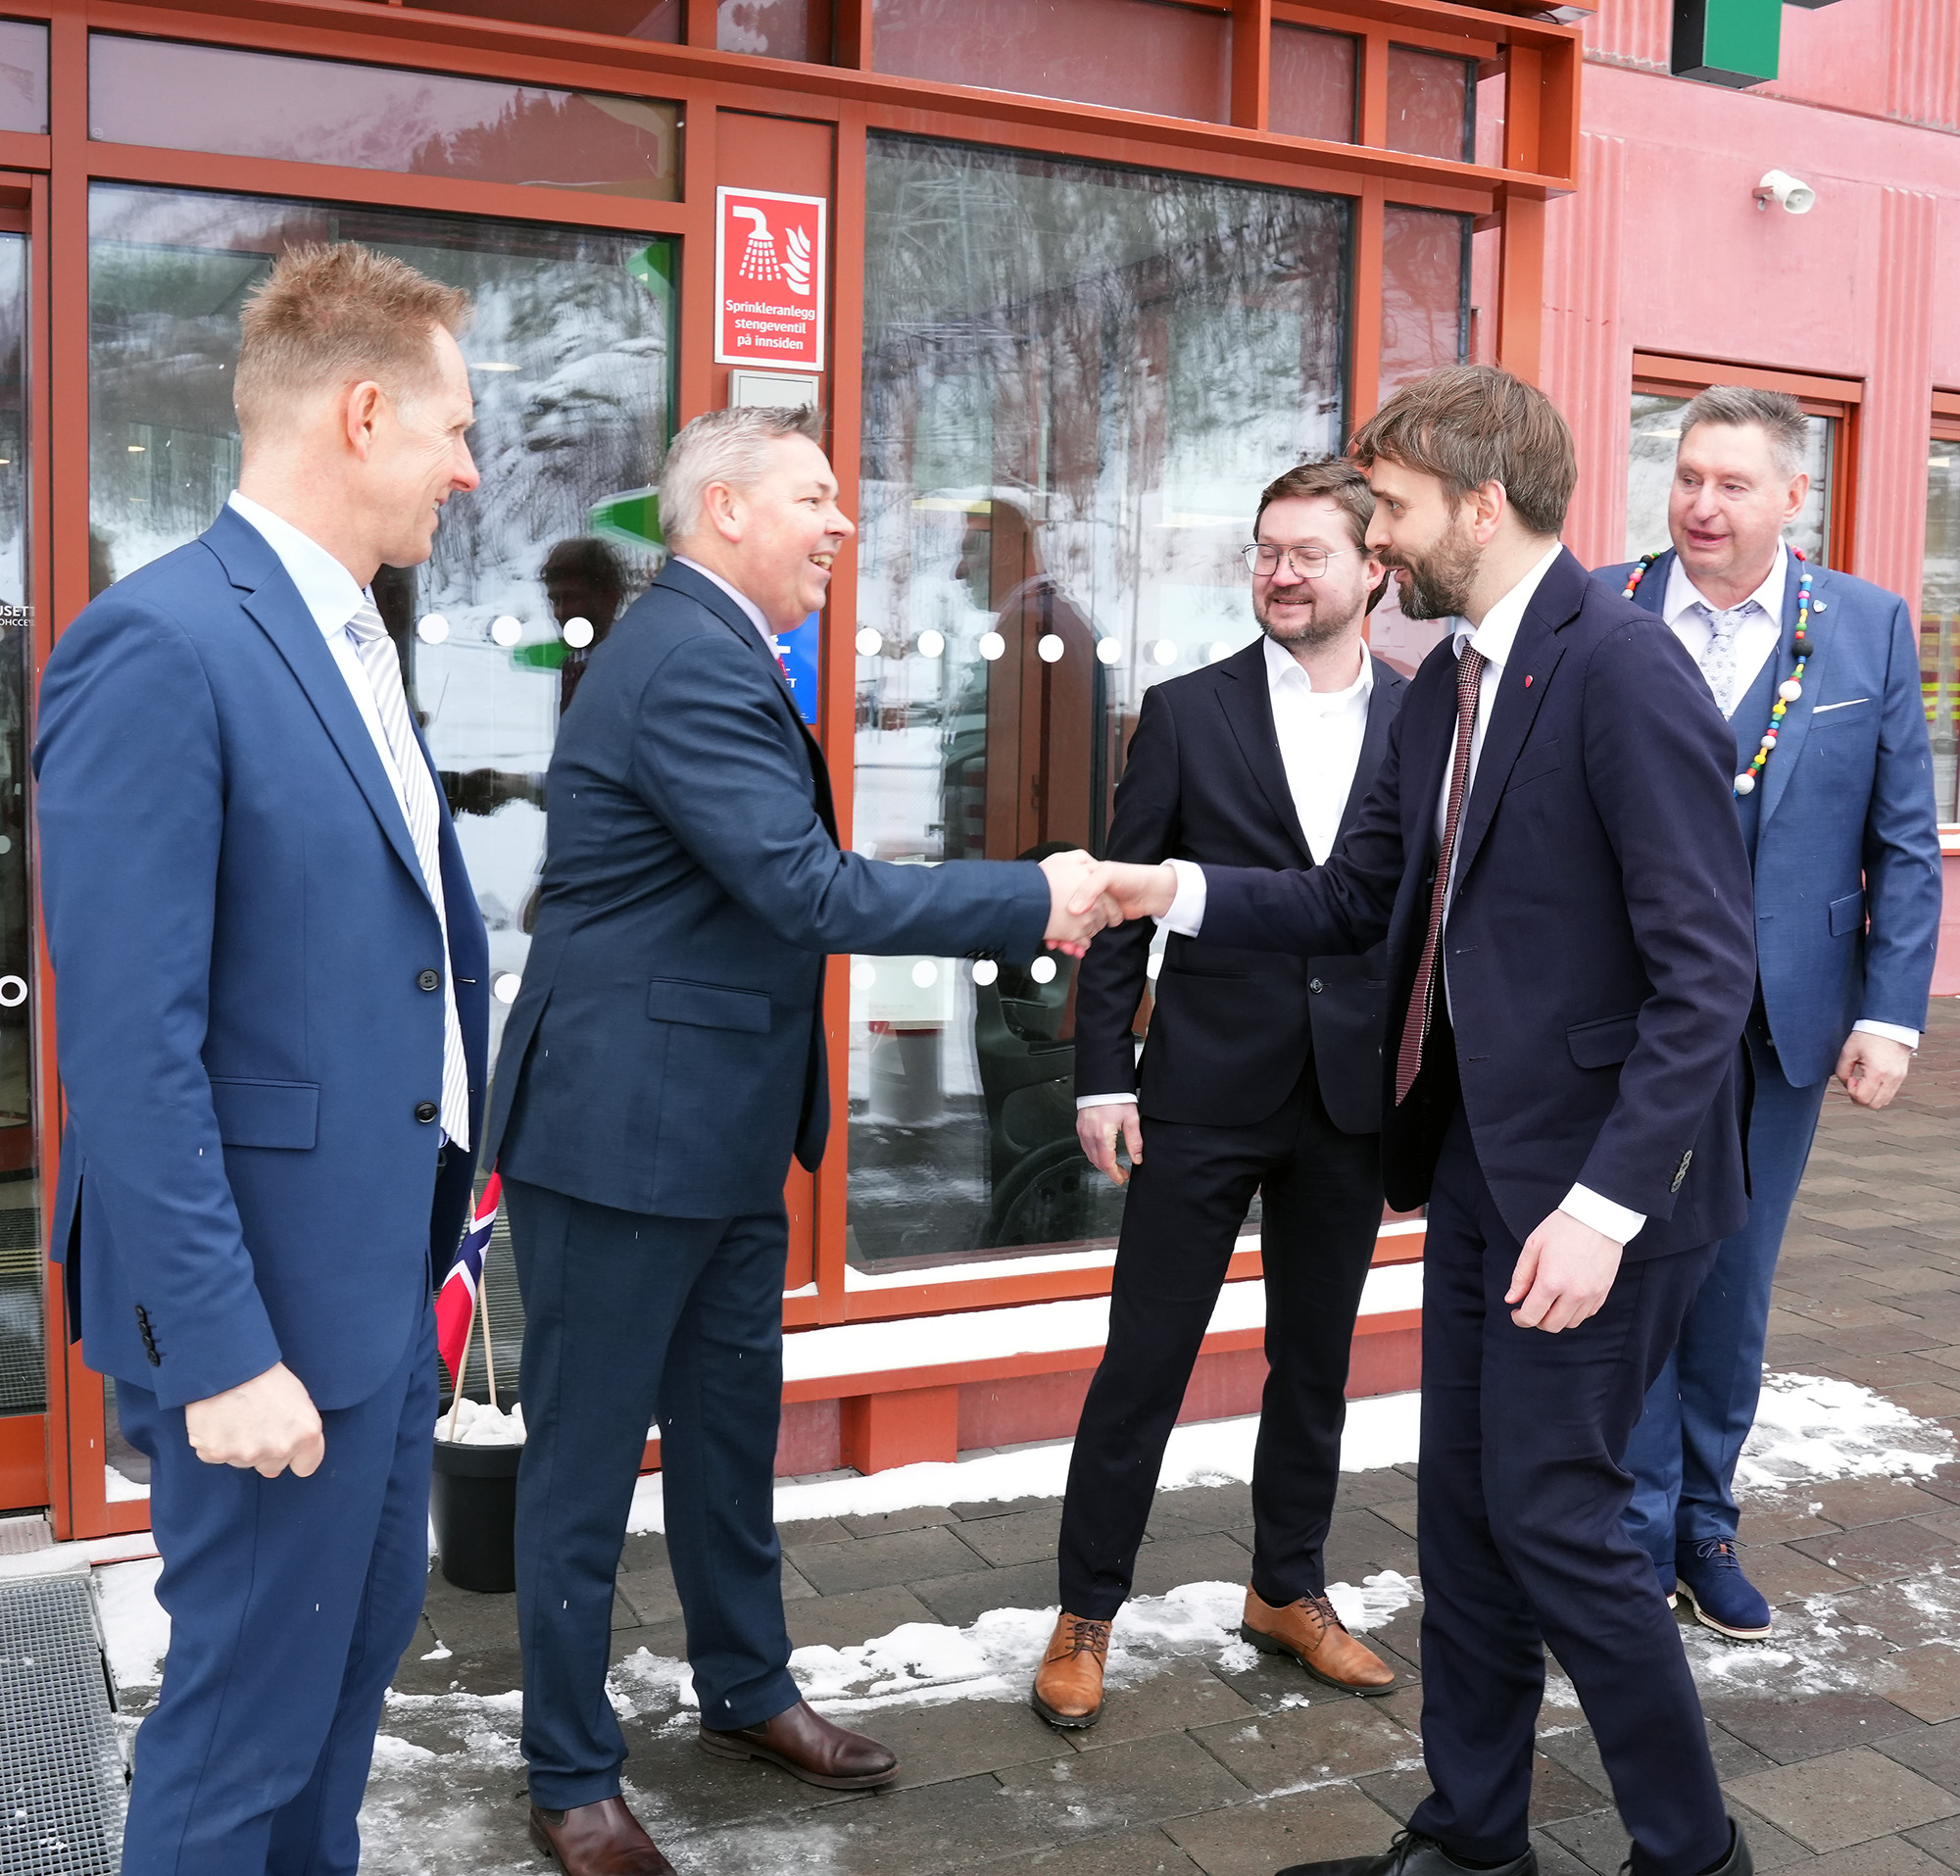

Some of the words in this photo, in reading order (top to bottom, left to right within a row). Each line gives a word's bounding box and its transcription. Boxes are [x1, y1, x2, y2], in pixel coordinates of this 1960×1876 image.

[725, 299, 815, 321] Sprinkleranlegg
[734, 319, 807, 334] stengeventil
[737, 333, 752, 347] på
[755, 335, 804, 350] innsiden
